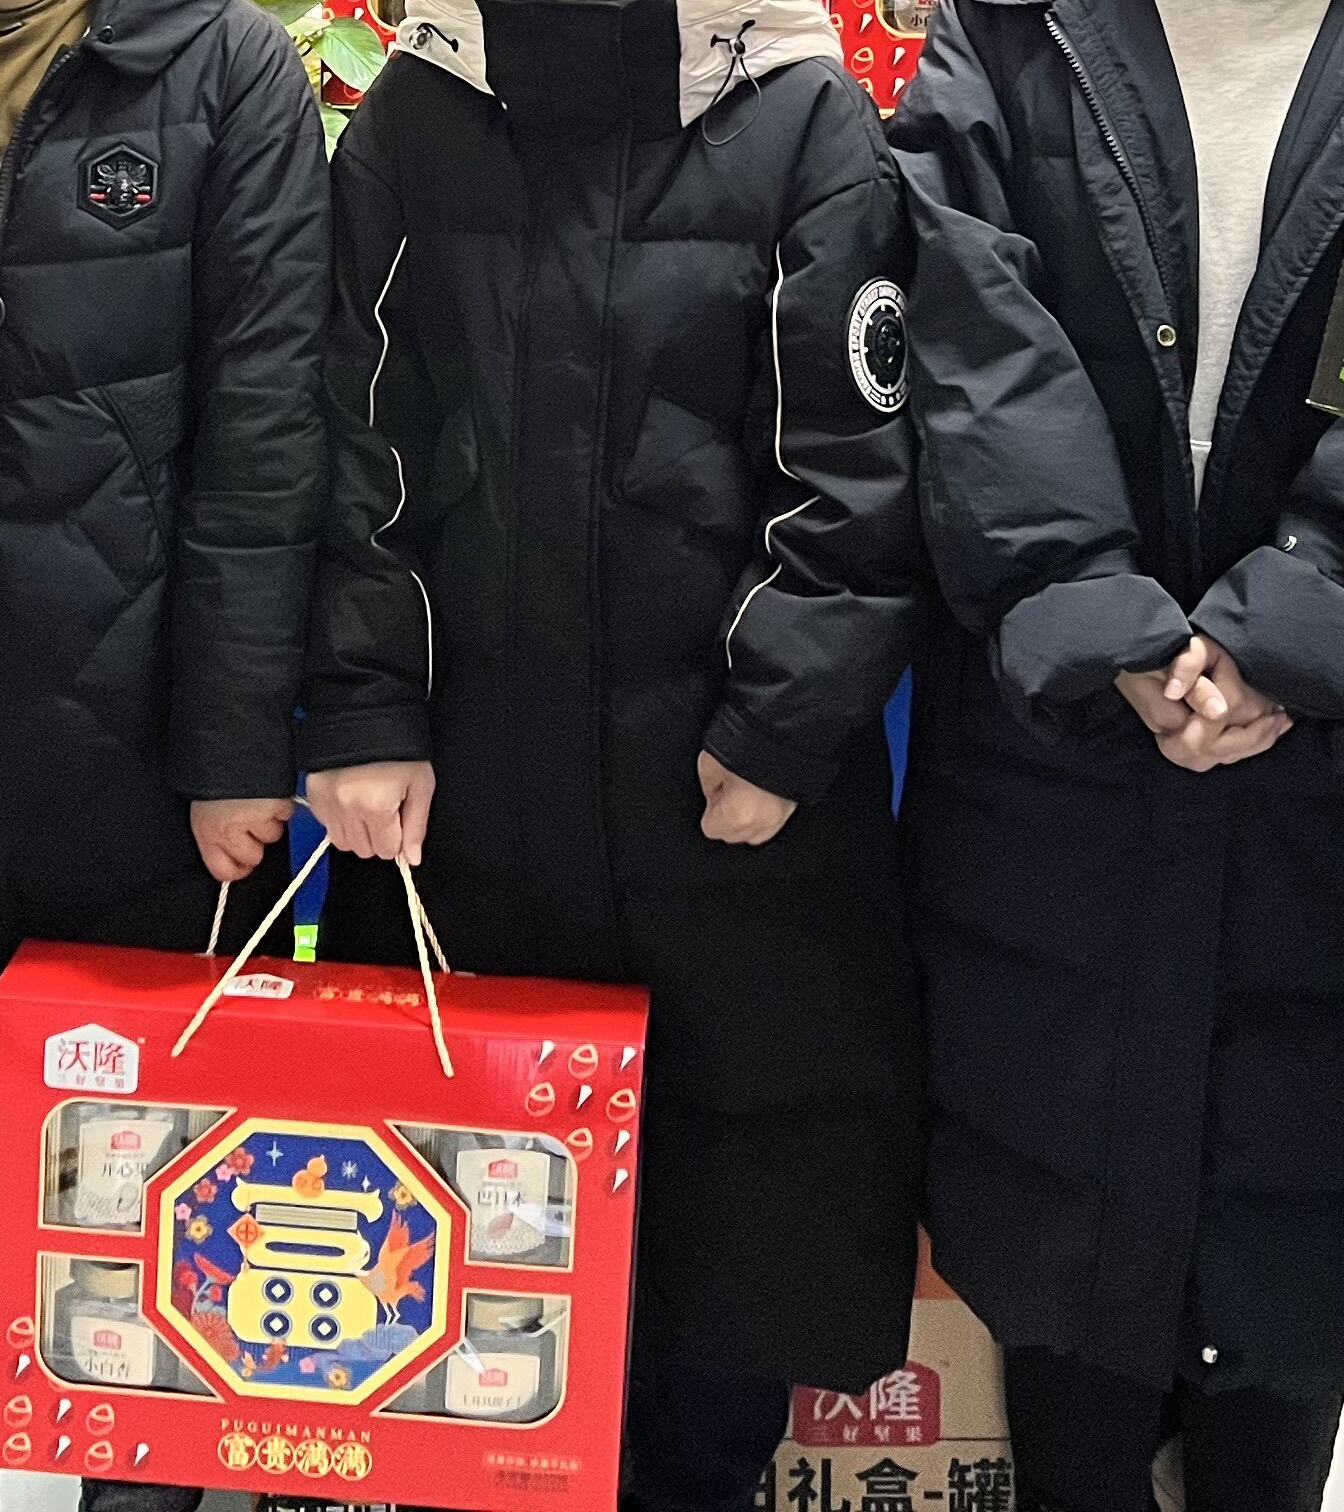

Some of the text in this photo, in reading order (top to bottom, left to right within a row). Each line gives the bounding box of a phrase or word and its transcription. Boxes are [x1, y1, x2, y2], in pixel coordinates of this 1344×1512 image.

[57, 1038, 125, 1075] 沃隆
[221, 1418, 371, 1443] FUGUIMANMAN
[218, 1433, 373, 1481] 富贵满满
